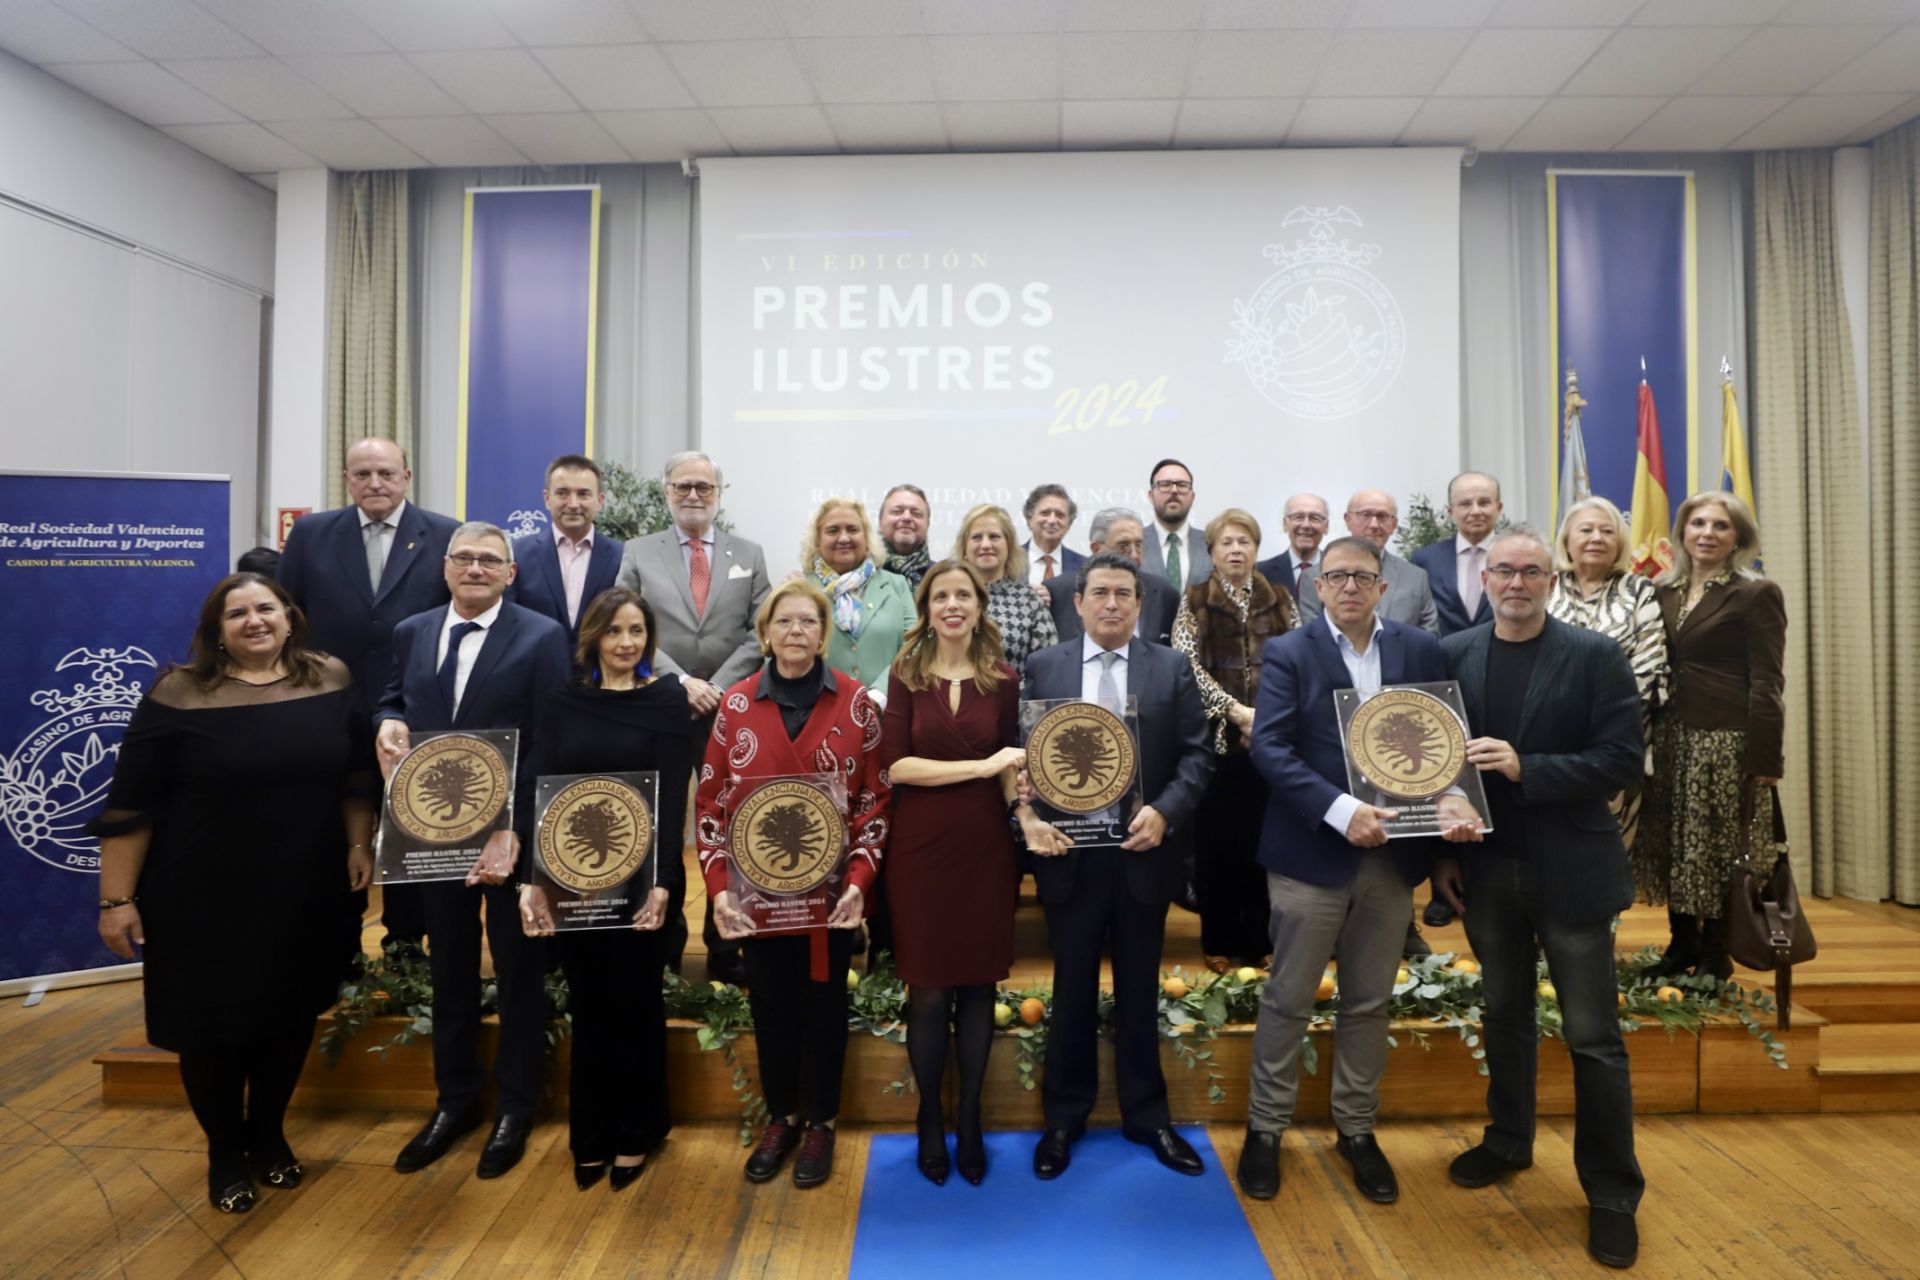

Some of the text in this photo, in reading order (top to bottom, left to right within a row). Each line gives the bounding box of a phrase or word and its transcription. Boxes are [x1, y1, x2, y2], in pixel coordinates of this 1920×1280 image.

[762, 248, 988, 272] VI EDICIÓN
[753, 281, 1053, 329] PREMIOS
[753, 345, 1054, 392] ILUSTRES
[1047, 374, 1168, 435] 2024
[0, 523, 205, 537] Real Sociedad Valenciana
[0, 537, 205, 551] de Agricultura y Deportes
[6, 559, 196, 568] CASINO DE AGRICULTURA VALENCIA
[21, 711, 133, 764] CASINO DE AGR
[543, 781, 647, 885] REAL SOCIEDAD VALENCIANA DE AGRICVLTVRA
[735, 784, 840, 885] REAL SOCIEDAD VALENCIANA DE AGRICVLTVRA
[405, 848, 481, 859] PREMIO ILUSTRE 2024
[583, 899, 609, 907] ILUSTRE
[754, 902, 780, 910] PREMIO
